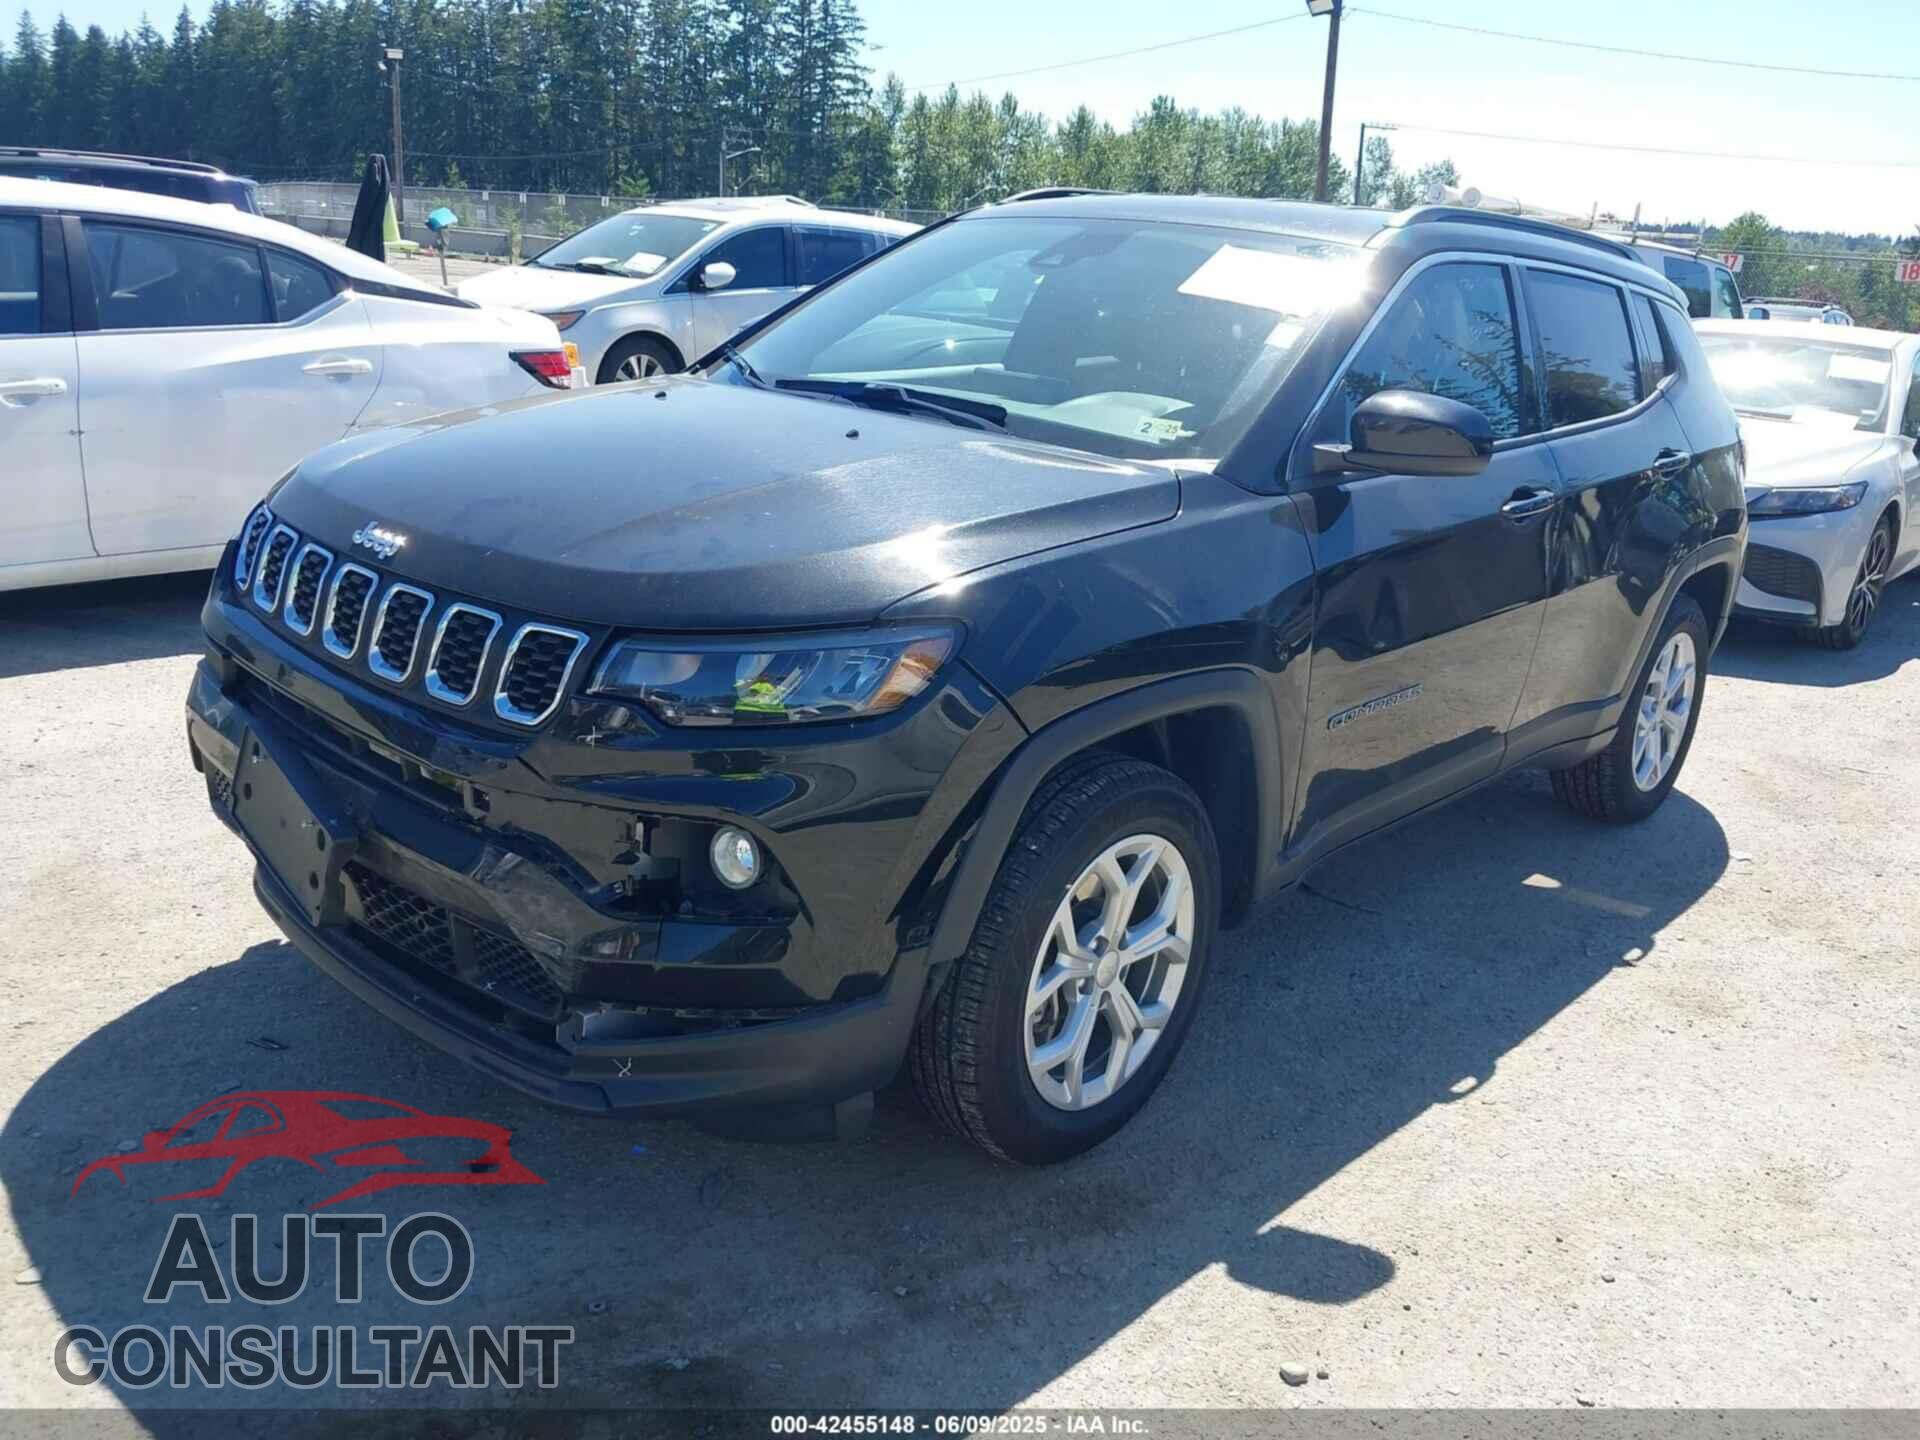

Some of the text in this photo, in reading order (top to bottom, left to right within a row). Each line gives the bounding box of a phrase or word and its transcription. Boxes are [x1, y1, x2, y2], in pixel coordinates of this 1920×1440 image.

[1140, 421, 1153, 434] 2
[352, 520, 408, 560] Jeep
[1327, 683, 1423, 730] COMPASS
